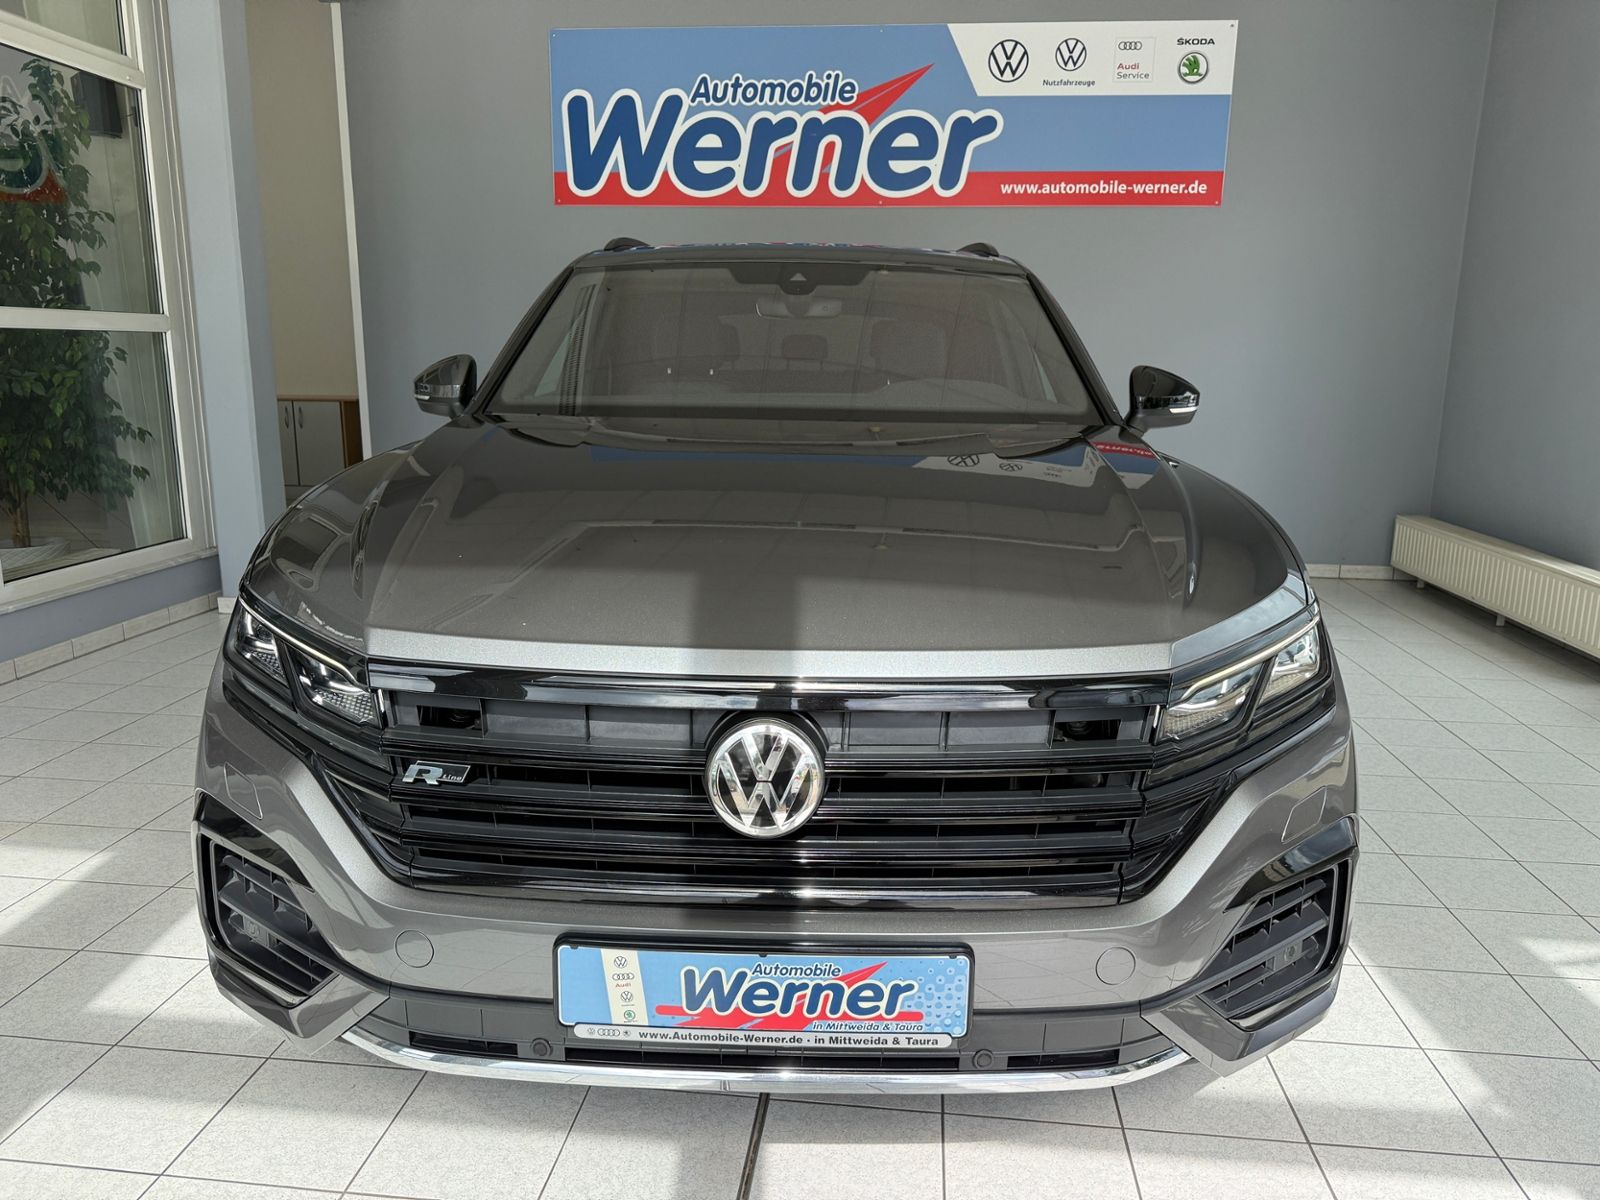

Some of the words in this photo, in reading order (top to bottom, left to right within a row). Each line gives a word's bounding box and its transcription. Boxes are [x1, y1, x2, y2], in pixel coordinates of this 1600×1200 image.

[1117, 62, 1139, 70] Audi
[1116, 71, 1149, 79] Service
[690, 71, 857, 104] Automobile
[1042, 79, 1096, 87] Nutzfahrzeuge
[565, 90, 1001, 195] Werner
[1000, 180, 1208, 195] www.automobile-werner.de
[752, 963, 841, 978] Automobile
[682, 967, 917, 1017] Werner
[813, 1021, 823, 1030] in
[825, 1021, 880, 1031] Mittweida
[882, 1022, 892, 1031] &
[895, 1022, 924, 1031] Taura
[638, 1031, 803, 1044] www.Automobile-Werner.de
[828, 1037, 888, 1046] Mittweida
[891, 1037, 901, 1045] &
[905, 1037, 939, 1046] Taura
